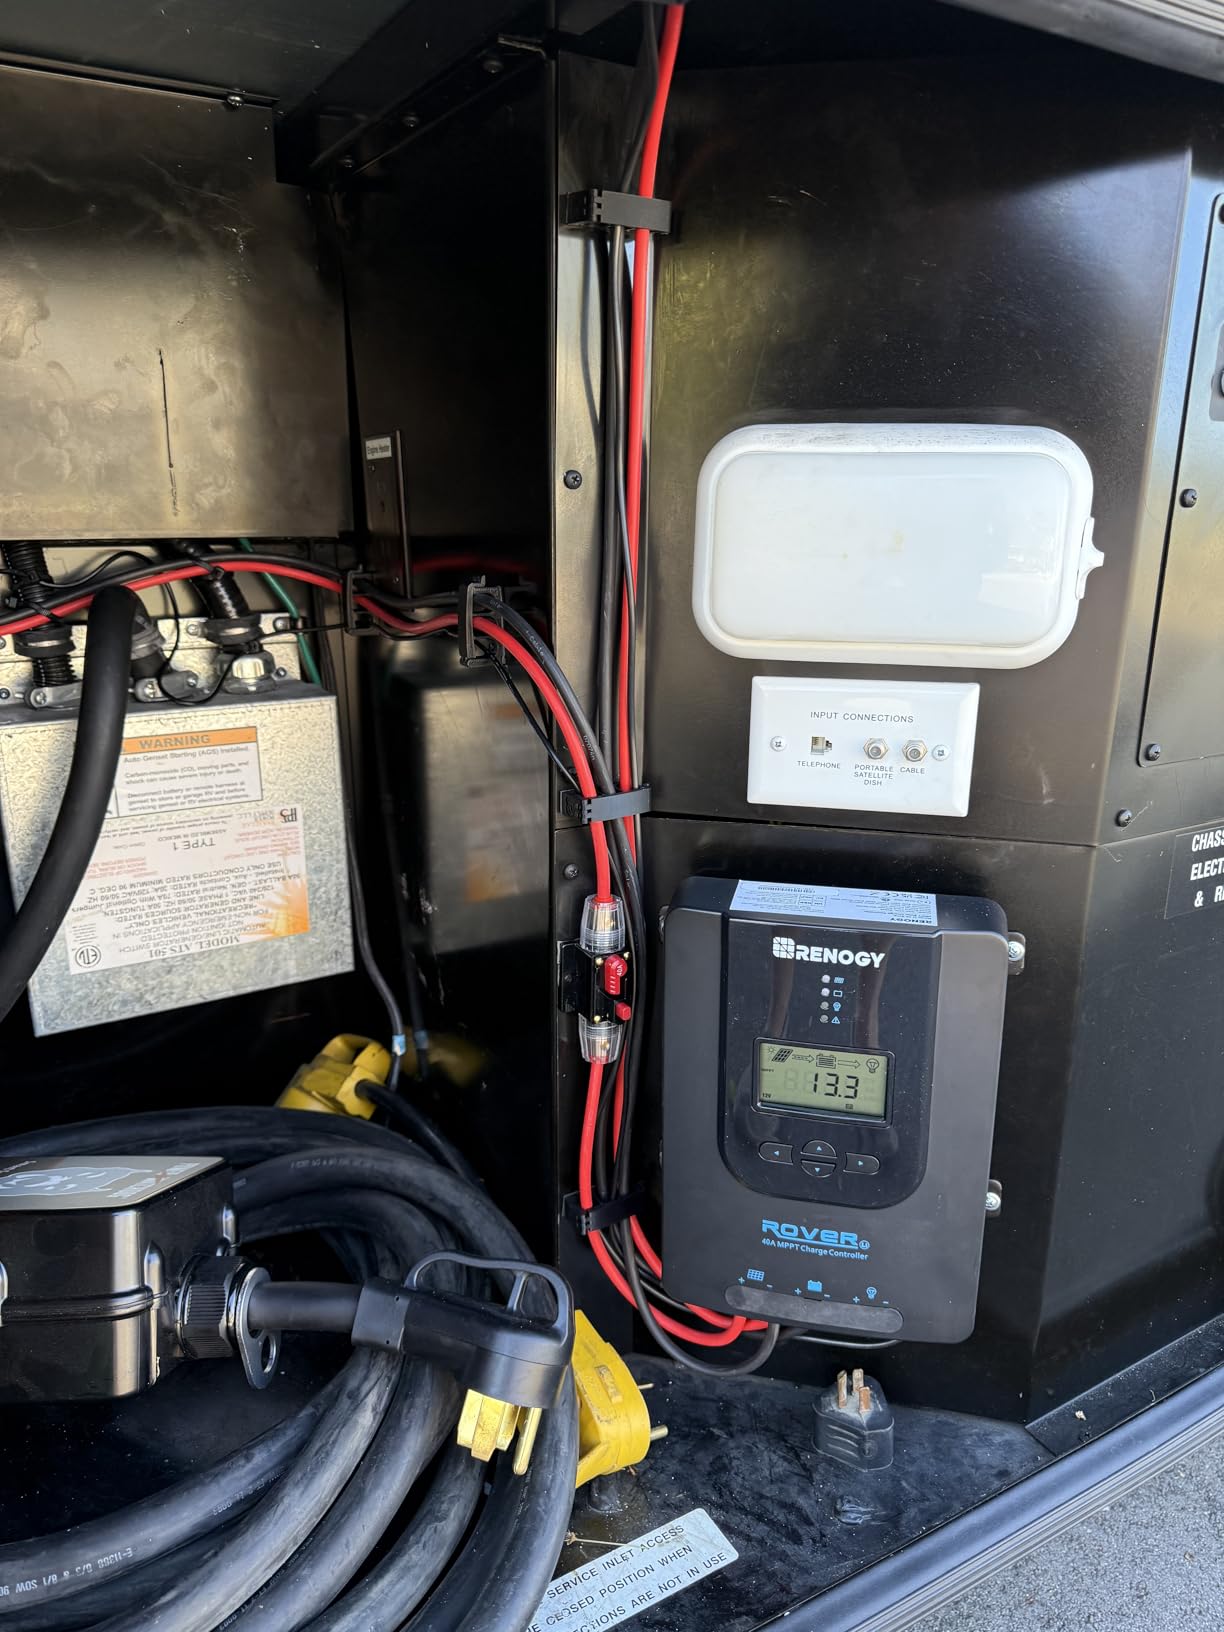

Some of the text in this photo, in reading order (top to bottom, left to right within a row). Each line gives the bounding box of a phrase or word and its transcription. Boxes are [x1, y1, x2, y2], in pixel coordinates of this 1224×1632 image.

[810, 711, 914, 724] INPUT CONNECTIONS
[139, 734, 210, 749] WARNING
[797, 760, 841, 769] TELEPHONE
[854, 764, 894, 772] PORTABLE
[900, 766, 925, 774] CABLE
[854, 772, 894, 780] SATELLITE
[171, 836, 215, 851] TYPE 1
[192, 866, 244, 879] CONDUCTORS
[246, 863, 264, 871] ONLY
[129, 878, 163, 888] MINIMUM
[165, 874, 190, 883] RATED
[198, 892, 223, 901] PHASE
[1194, 890, 1204, 908] &
[183, 899, 229, 911] GENERATOR
[144, 907, 180, 918] SOURCES
[152, 913, 191, 924] VEHICLES
[122, 922, 180, 937] APPLICATIONS
[140, 928, 189, 942] PROTECTED
[222, 922, 265, 935] AUTOMATIC
[118, 942, 150, 953] SWITCH
[148, 934, 239, 958] MODEL ATS 501
[796, 945, 885, 968] RENOGY
[813, 1072, 860, 1099] 13.3
[762, 1220, 858, 1248] ROVER
[762, 1238, 868, 1260] 40A MPPT Charge Controller
[547, 1524, 685, 1599] SERVICE INLET ACCESS
[598, 1563, 655, 1598] POSITION
[656, 1544, 694, 1568] WHEN
[629, 1589, 655, 1608] ARE
[657, 1574, 684, 1593] NOT
[685, 1565, 700, 1578] IN
[701, 1552, 727, 1569] USE
